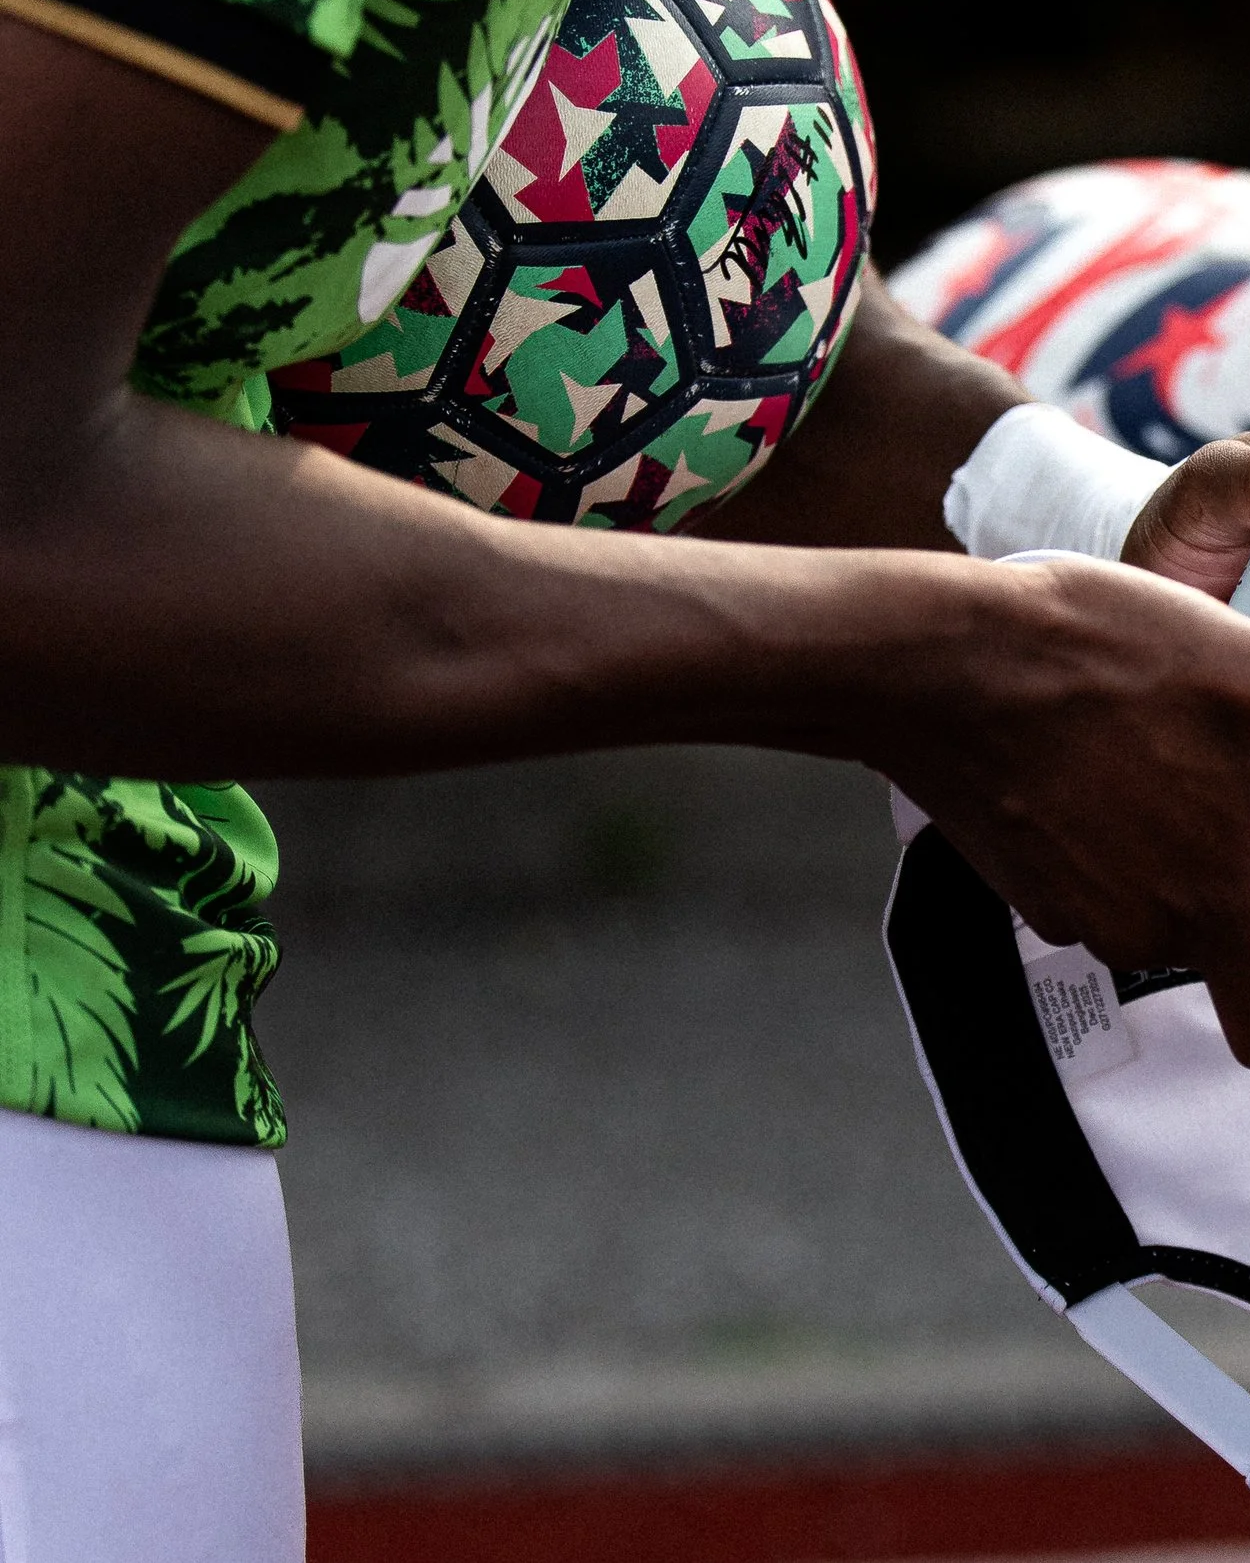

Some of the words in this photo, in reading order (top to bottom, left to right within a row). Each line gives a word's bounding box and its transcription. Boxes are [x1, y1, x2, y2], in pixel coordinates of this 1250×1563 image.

[1043, 975, 1054, 993] CO.
[1048, 995, 1061, 1014] CAP
[1069, 984, 1089, 1034] Bangladesh
[1055, 1015, 1068, 1035] ERA
[1061, 1037, 1075, 1059] NEW
